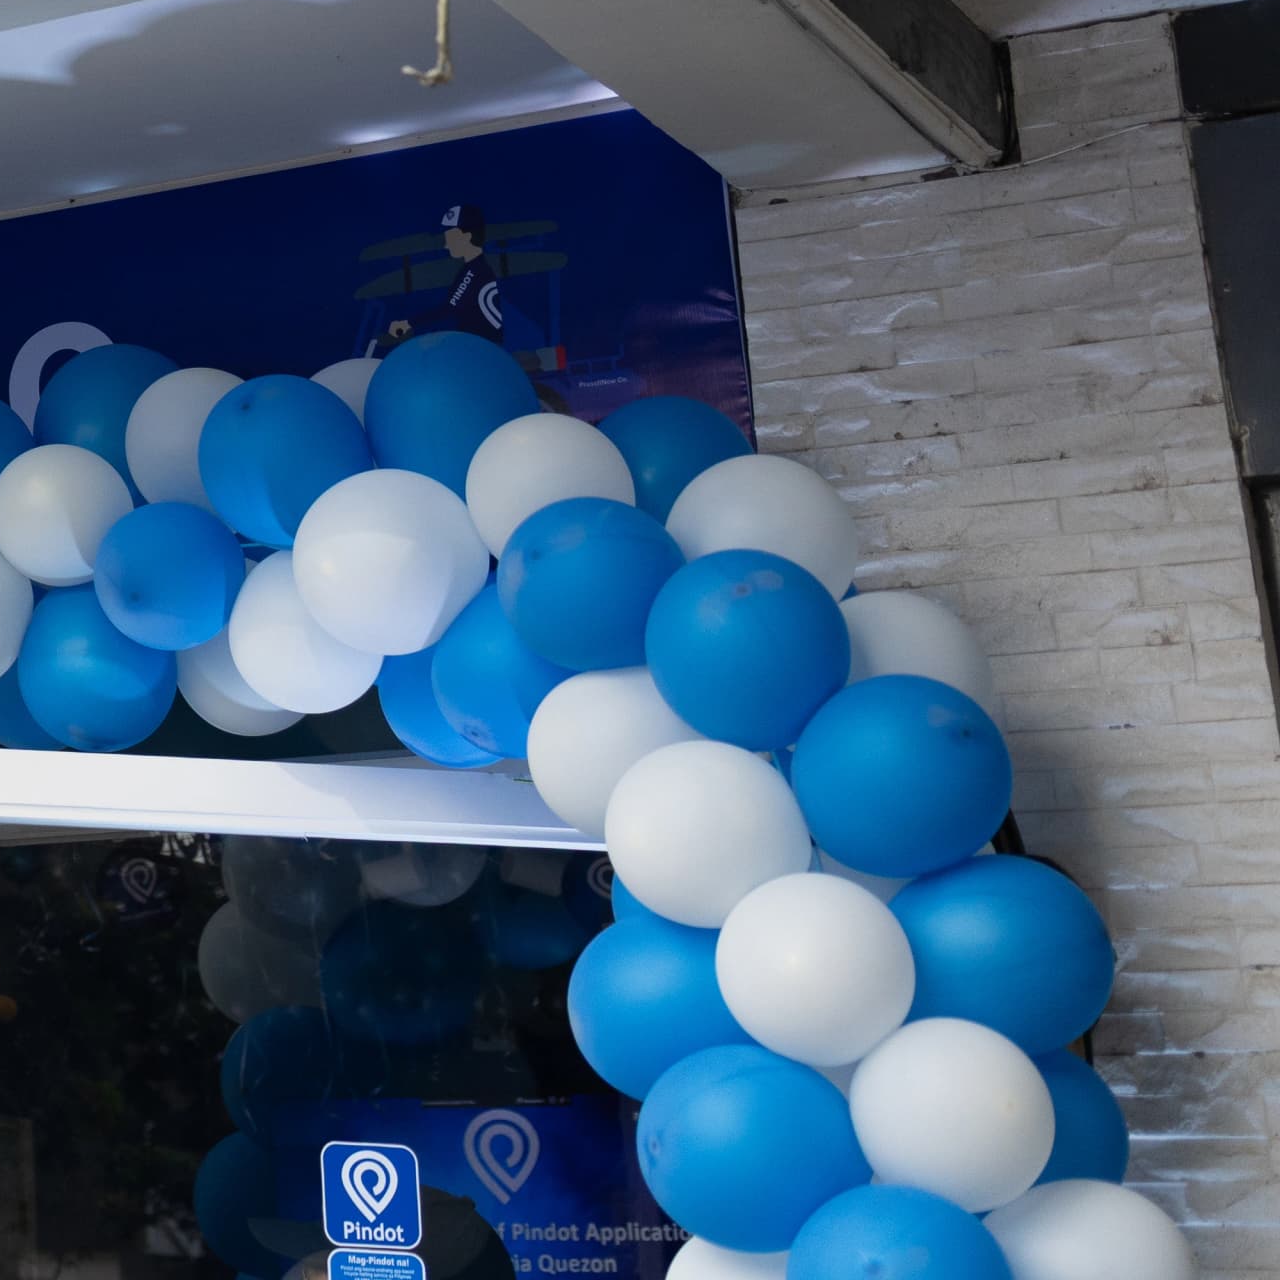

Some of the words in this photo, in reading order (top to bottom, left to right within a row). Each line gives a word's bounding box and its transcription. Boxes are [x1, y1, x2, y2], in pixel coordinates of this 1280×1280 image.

[449, 270, 475, 307] PINDOT
[343, 1221, 405, 1243] Pindot
[511, 1222, 579, 1241] Pindot
[348, 1255, 395, 1267] Mag-Pindot
[396, 1258, 410, 1268] na!
[537, 1254, 618, 1275] Quezon
